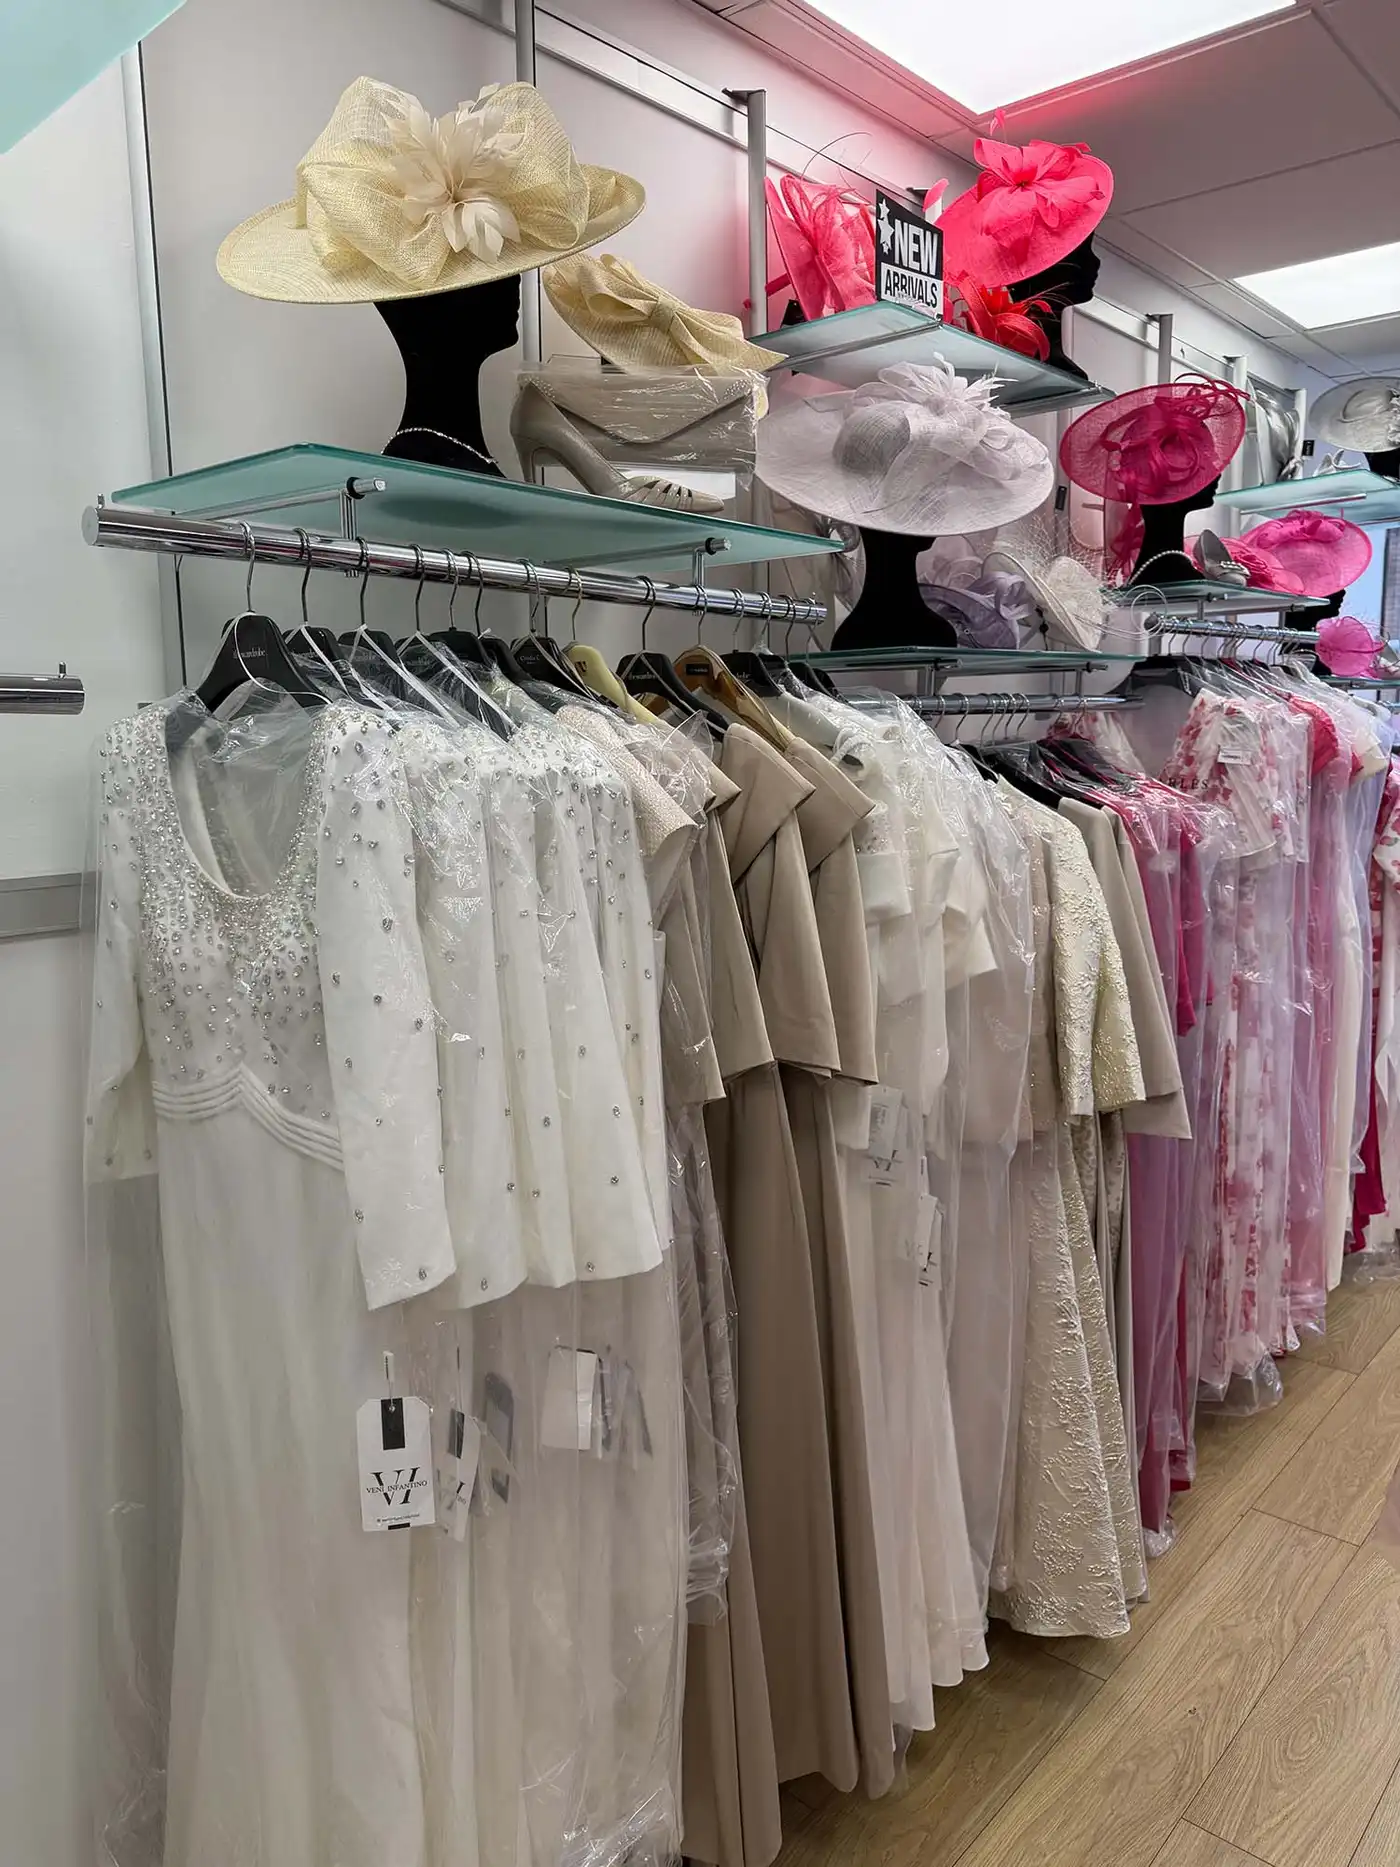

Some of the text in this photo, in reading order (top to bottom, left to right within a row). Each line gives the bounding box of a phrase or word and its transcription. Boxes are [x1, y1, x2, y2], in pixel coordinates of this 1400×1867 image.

[894, 218, 938, 275] NEW
[885, 269, 938, 308] ARRIVALS
[366, 1480, 428, 1494] VENI INFANTINO
[370, 1467, 421, 1506] VI
